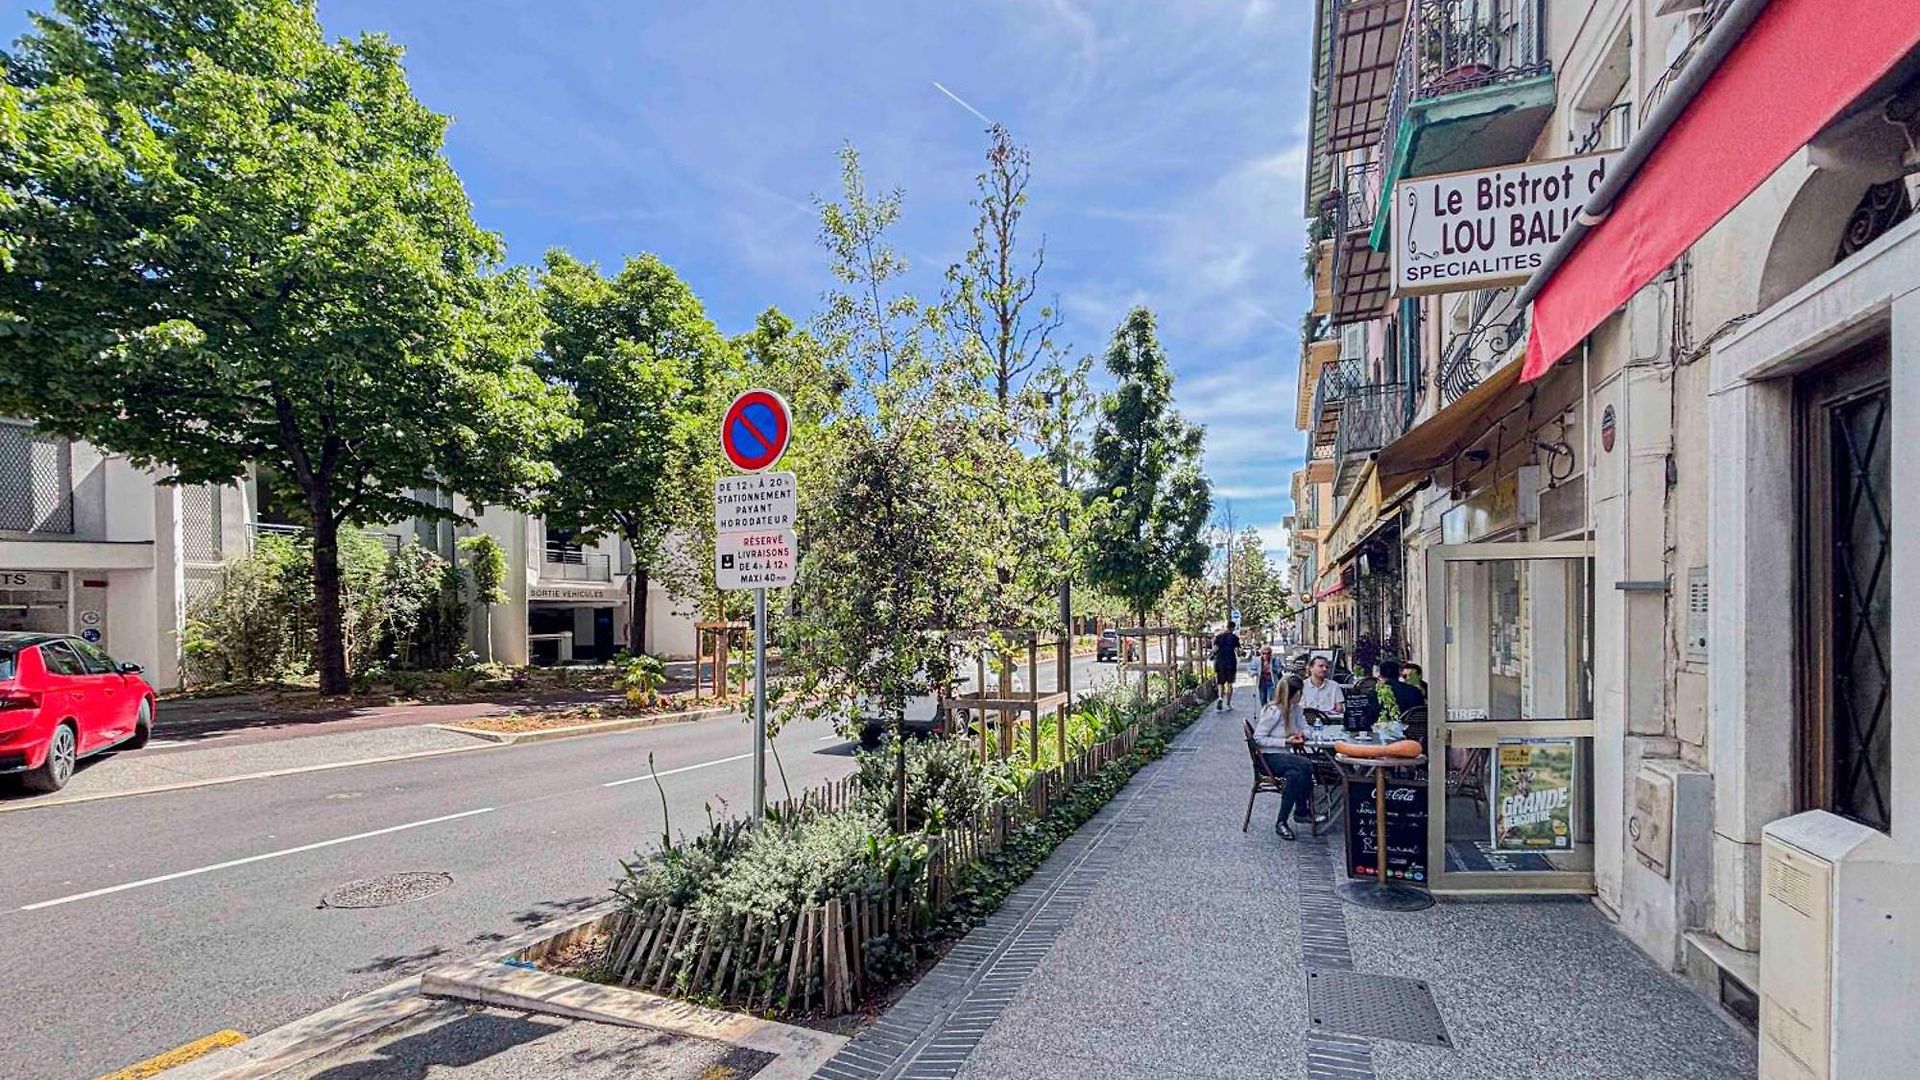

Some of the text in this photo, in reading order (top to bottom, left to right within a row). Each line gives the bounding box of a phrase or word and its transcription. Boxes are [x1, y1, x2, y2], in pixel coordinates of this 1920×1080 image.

[1434, 184, 1462, 217] Le
[1477, 165, 1574, 211] Bistrot
[1442, 216, 1496, 255] LOU
[1407, 253, 1542, 282] SPECIALITES
[719, 483, 732, 492] DE
[717, 490, 791, 504] STATIONNEMENT
[736, 504, 772, 514] PAYANT
[720, 515, 788, 528] HORODATEUR
[738, 548, 789, 559] LIVRAISONS
[739, 563, 750, 571] DE
[740, 574, 762, 583] MAXI
[530, 589, 561, 598] SORTIE
[1502, 787, 1568, 816] GRANDE
